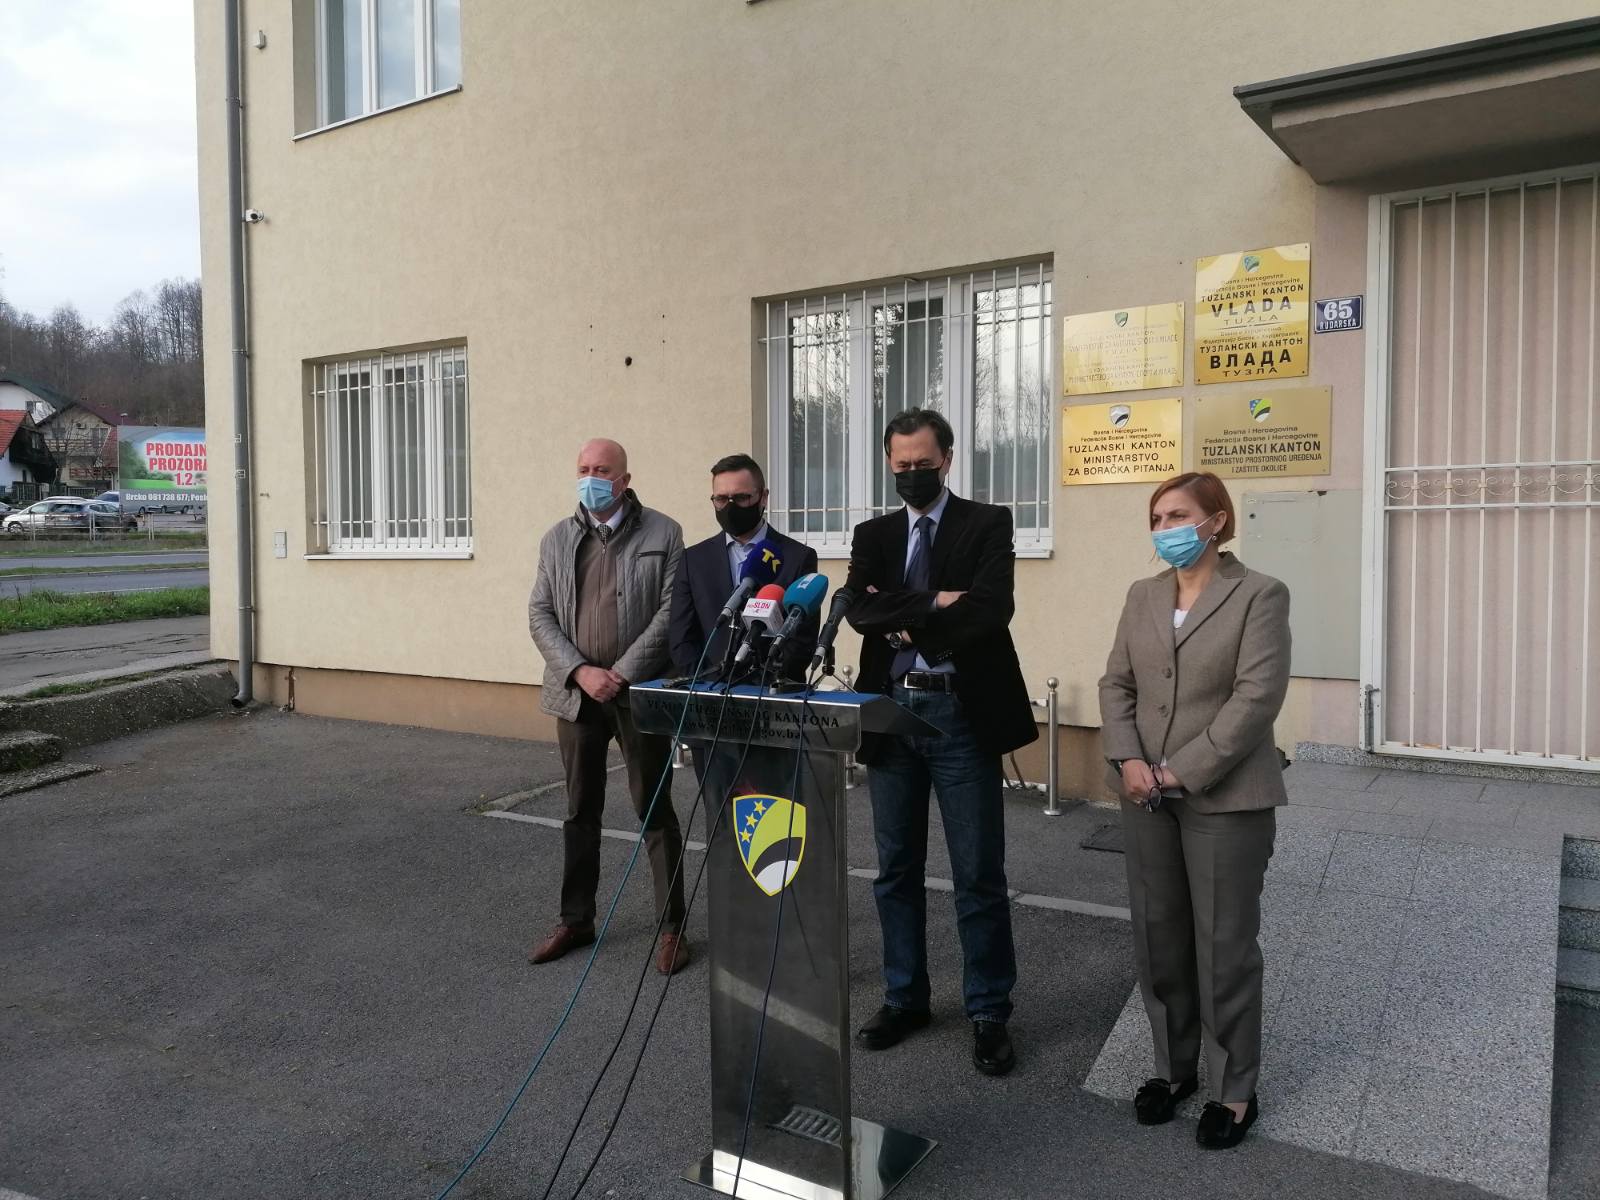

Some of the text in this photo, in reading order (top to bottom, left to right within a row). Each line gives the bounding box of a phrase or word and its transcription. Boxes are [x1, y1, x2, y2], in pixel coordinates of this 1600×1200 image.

[1201, 283, 1304, 303] TUZLANSKI KANTON
[1211, 296, 1291, 317] VLADA
[1323, 300, 1353, 321] 65
[1224, 314, 1279, 326] TUZLA
[1319, 318, 1357, 330] RUDARSKA
[1200, 337, 1303, 354] ТУЗЛАНСКИ КАНТОН
[1210, 349, 1291, 369] ВЛАДА
[1223, 367, 1278, 377] ТУЗЛА
[1223, 428, 1246, 436] Bosna
[1252, 425, 1298, 435] Hercegovina
[1204, 437, 1241, 445] Federacija
[1272, 432, 1318, 441] Hercegovine
[1068, 440, 1176, 454] TUZLANSKI KANTON
[1202, 440, 1321, 457] TUZLANSKI KANTON
[1083, 453, 1159, 464] MINISTARSTVO
[1201, 456, 1244, 466] MINISTARSTVO
[1245, 454, 1287, 464] PROSTORNOG
[1068, 463, 1175, 476] ZA BORAČKA PITANJA
[1260, 464, 1288, 472] OKOLICE
[775, 711, 839, 728] KANTONA
